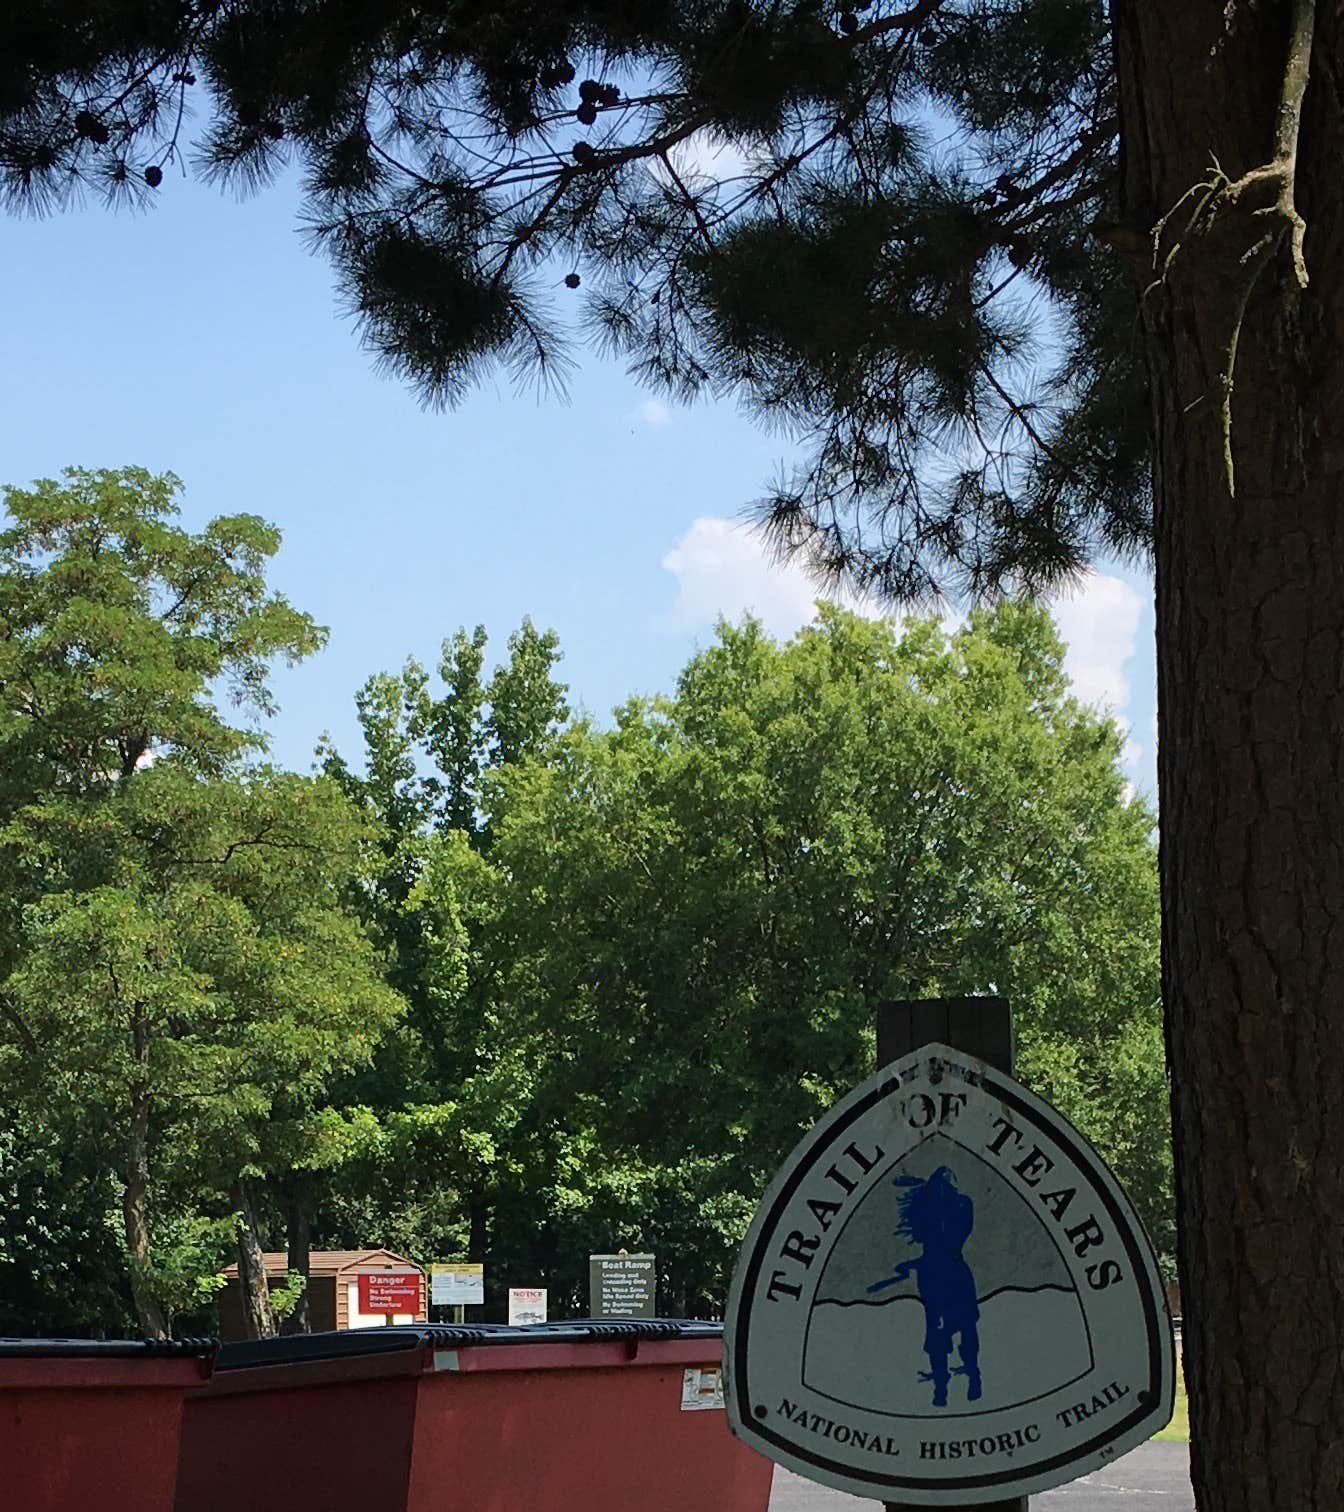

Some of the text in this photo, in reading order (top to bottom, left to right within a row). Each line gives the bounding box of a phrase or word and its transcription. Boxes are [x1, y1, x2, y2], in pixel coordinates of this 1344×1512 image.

[767, 1093, 1123, 1301] TRAIL OF TEARS
[369, 1276, 405, 1286] Danger
[602, 1261, 651, 1270] Boat Ramp
[777, 1379, 1130, 1459] NATIONAL HISTORIC TRAIL
